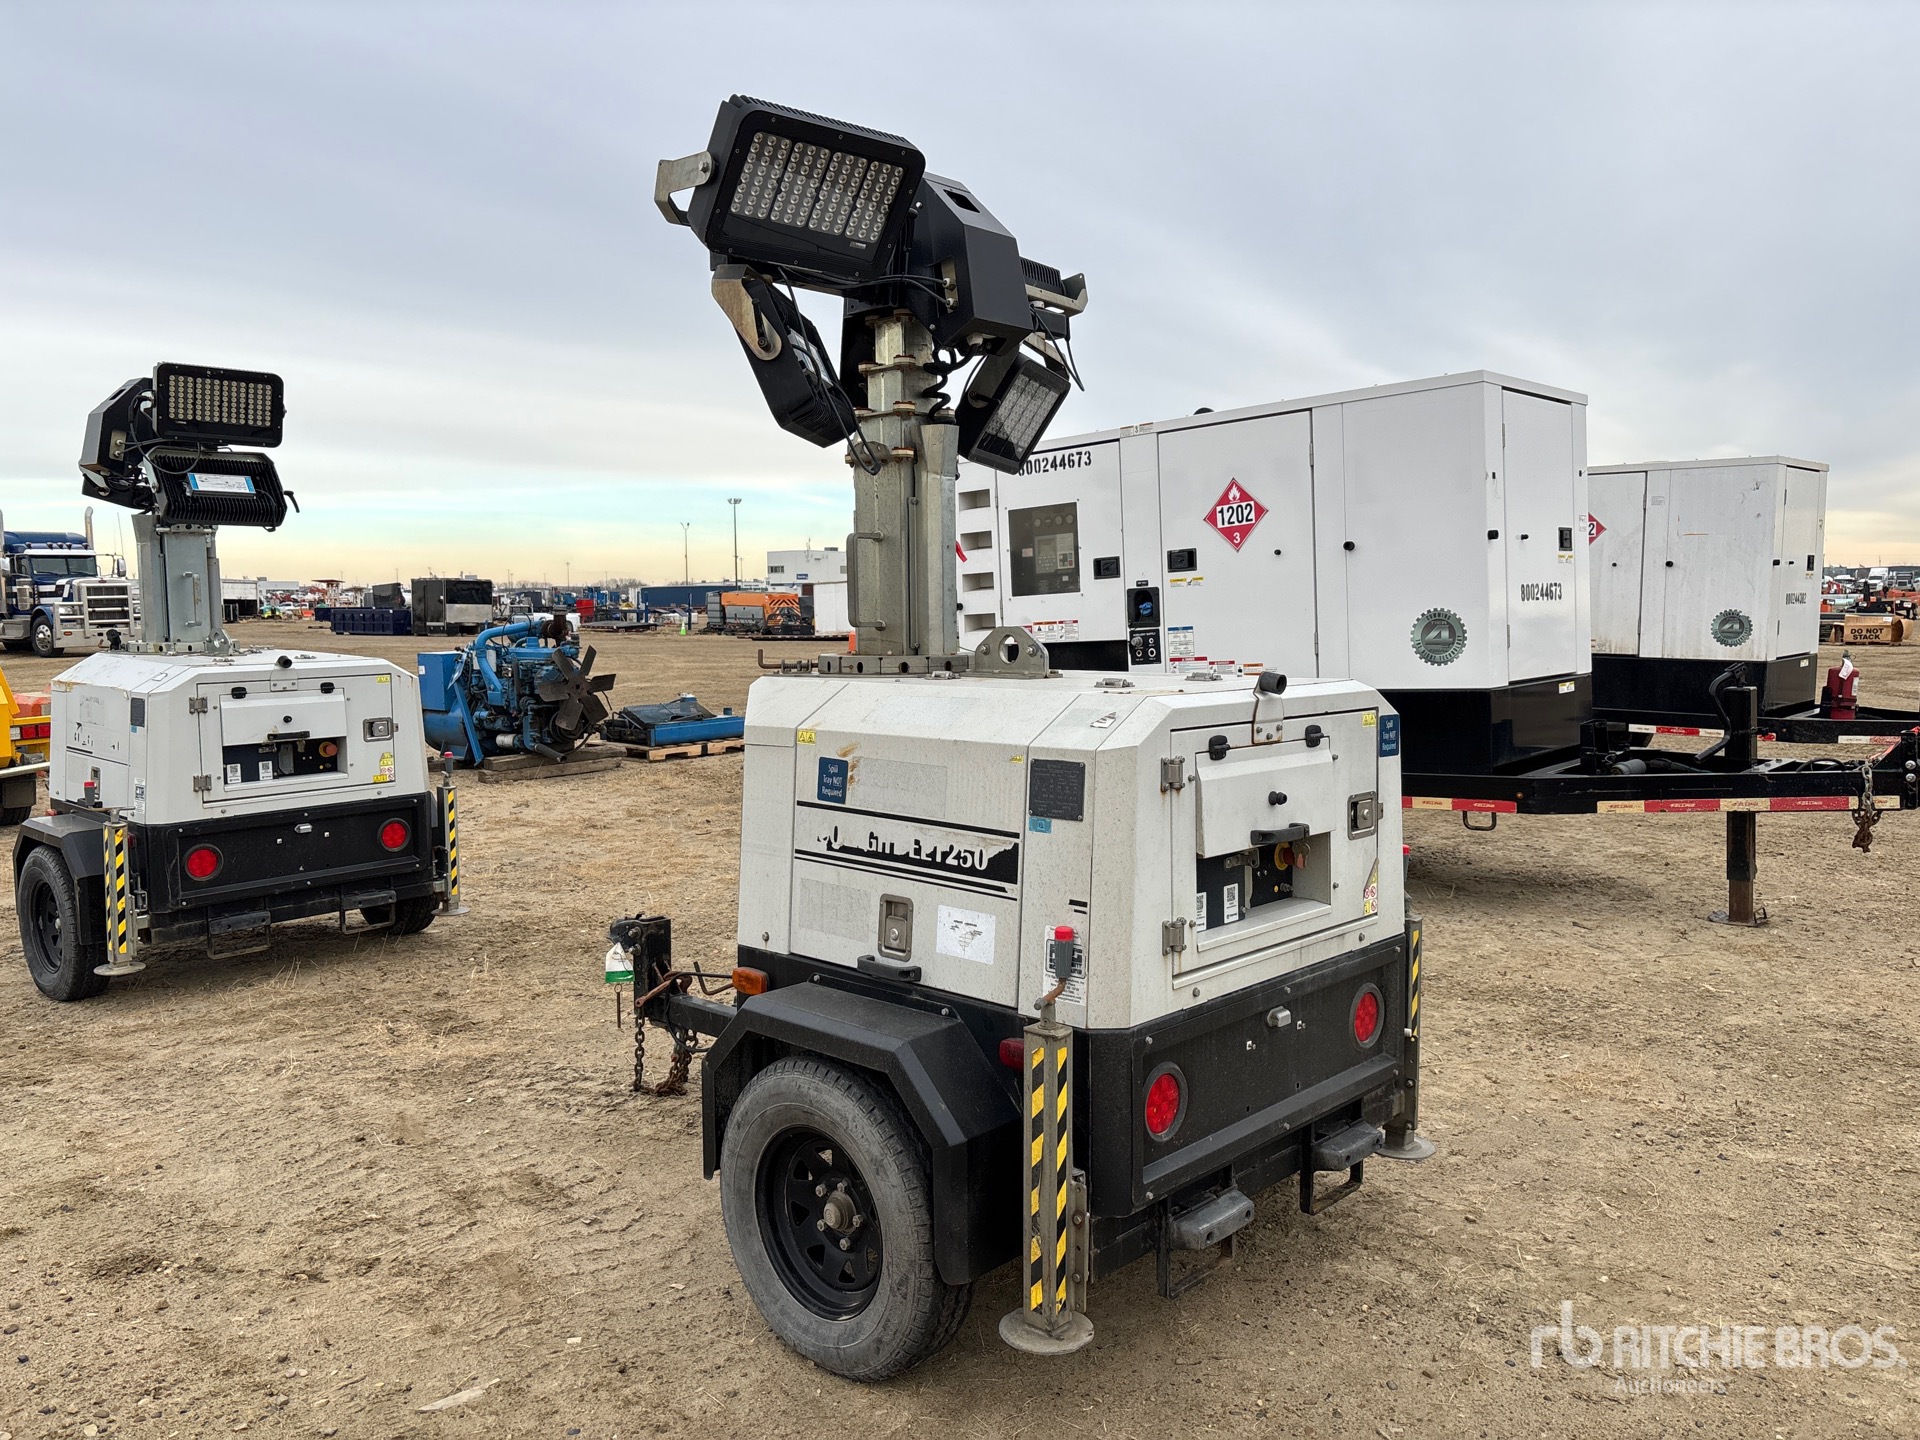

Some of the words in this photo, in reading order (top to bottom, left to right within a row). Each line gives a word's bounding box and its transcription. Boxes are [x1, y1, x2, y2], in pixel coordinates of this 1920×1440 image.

[1218, 503, 1253, 526] 1202
[1233, 532, 1241, 544] 3
[1520, 582, 1562, 601] 800244673
[1720, 620, 1742, 633] 4
[1866, 627, 1884, 635] NOT
[1424, 624, 1454, 646] 4
[828, 763, 839, 775] Spill
[823, 774, 833, 786] Tray
[832, 776, 843, 787] NOT
[821, 785, 843, 798] Required
